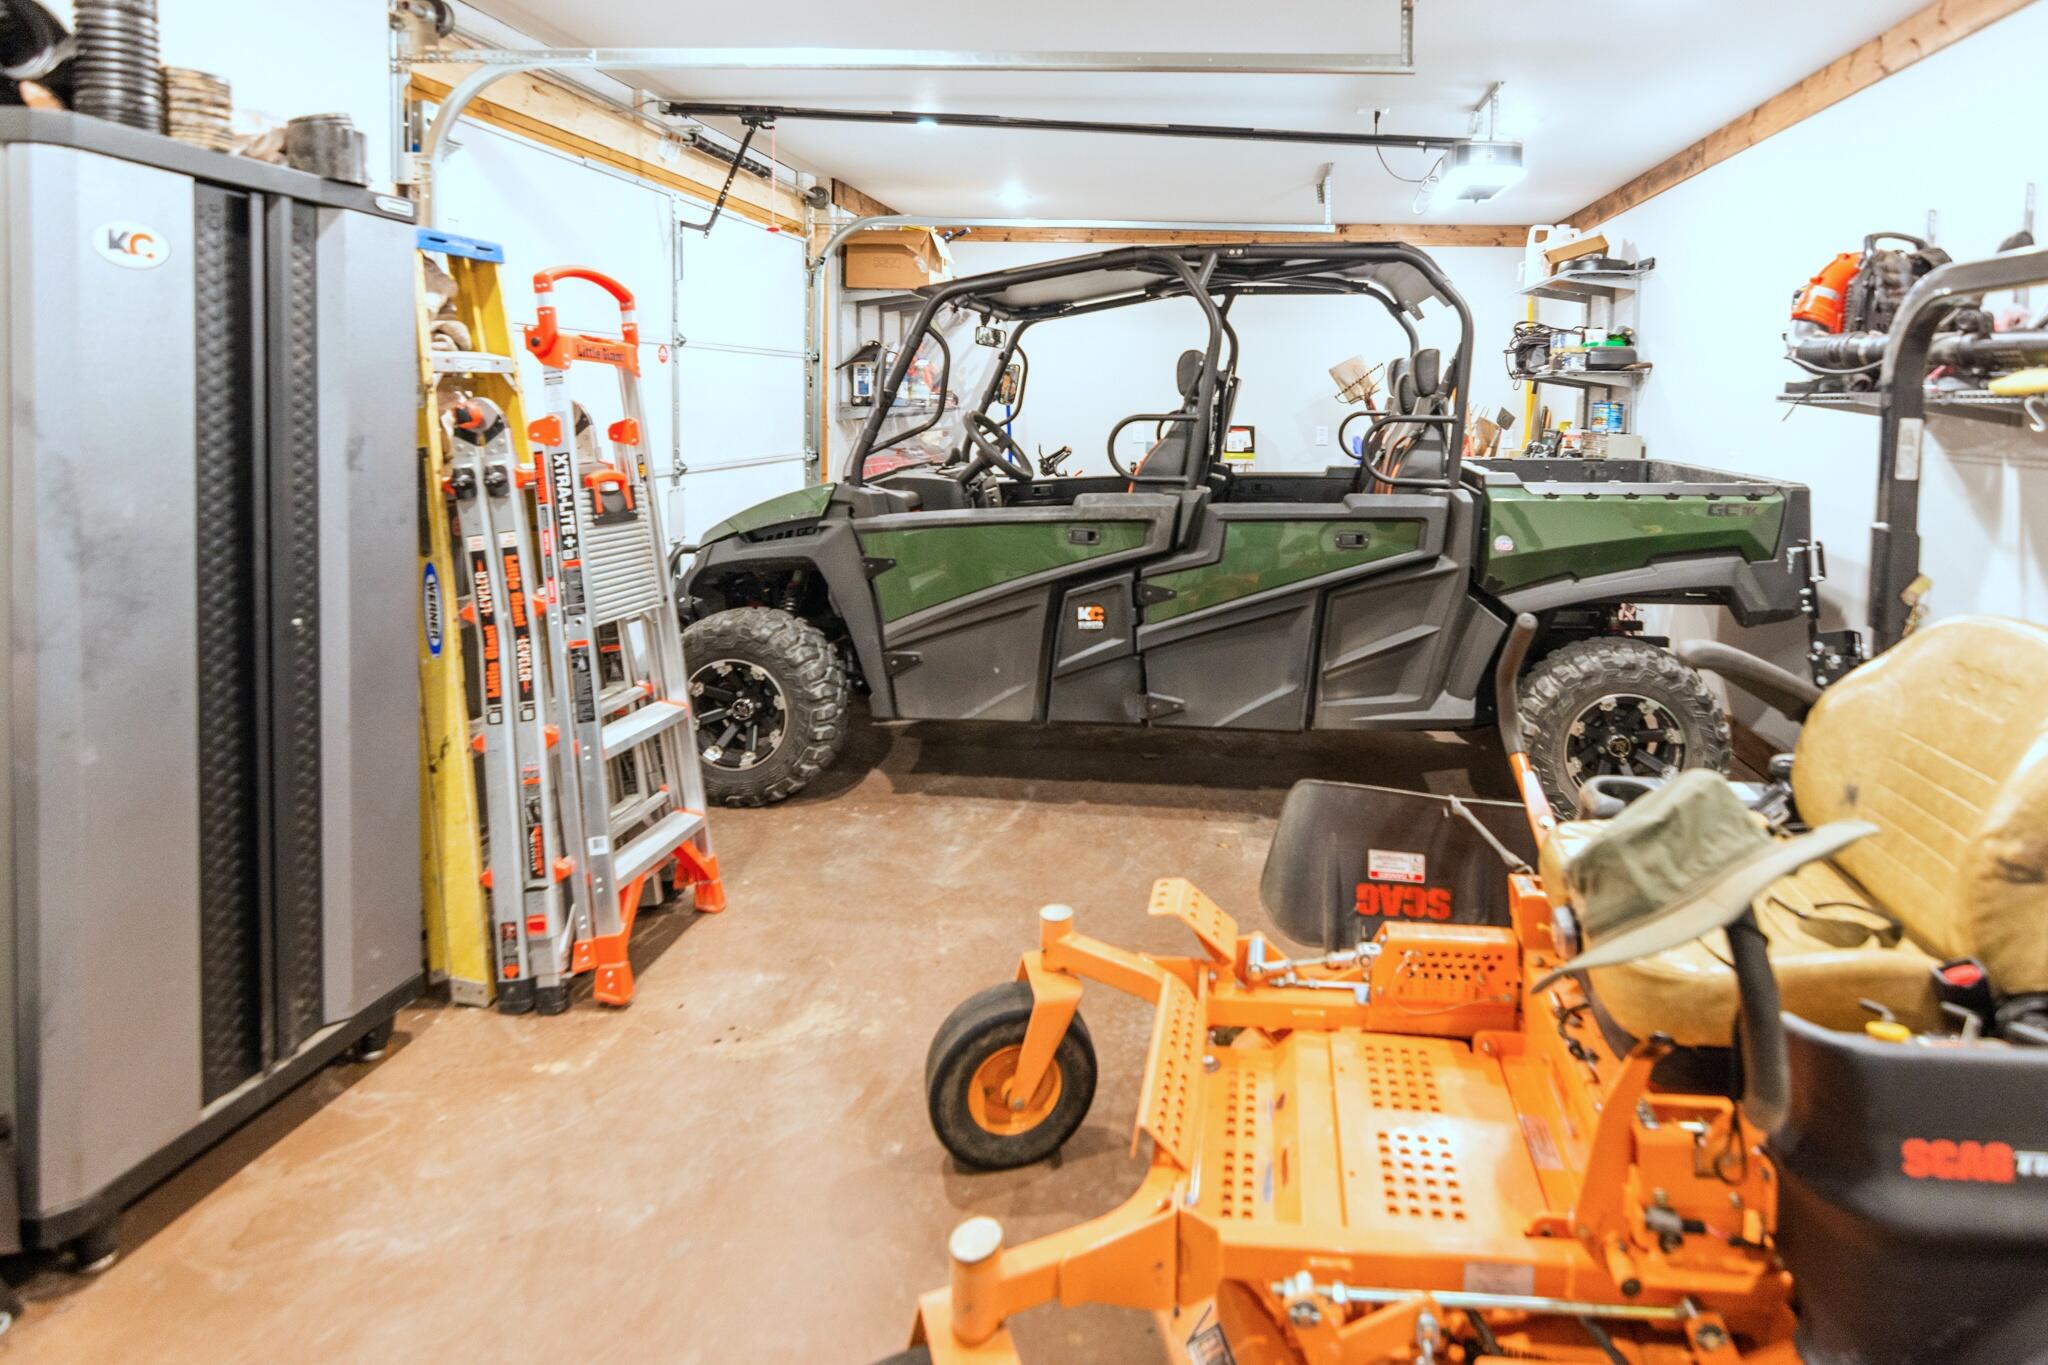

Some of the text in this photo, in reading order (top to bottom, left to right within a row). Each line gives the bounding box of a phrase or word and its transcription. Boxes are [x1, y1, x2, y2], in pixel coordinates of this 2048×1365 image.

[427, 582, 440, 639] WERNER
[475, 571, 502, 698] Little Giant LEVELER
[503, 554, 532, 681] Little Giant LEVELER
[1355, 883, 1452, 920] SCAG
